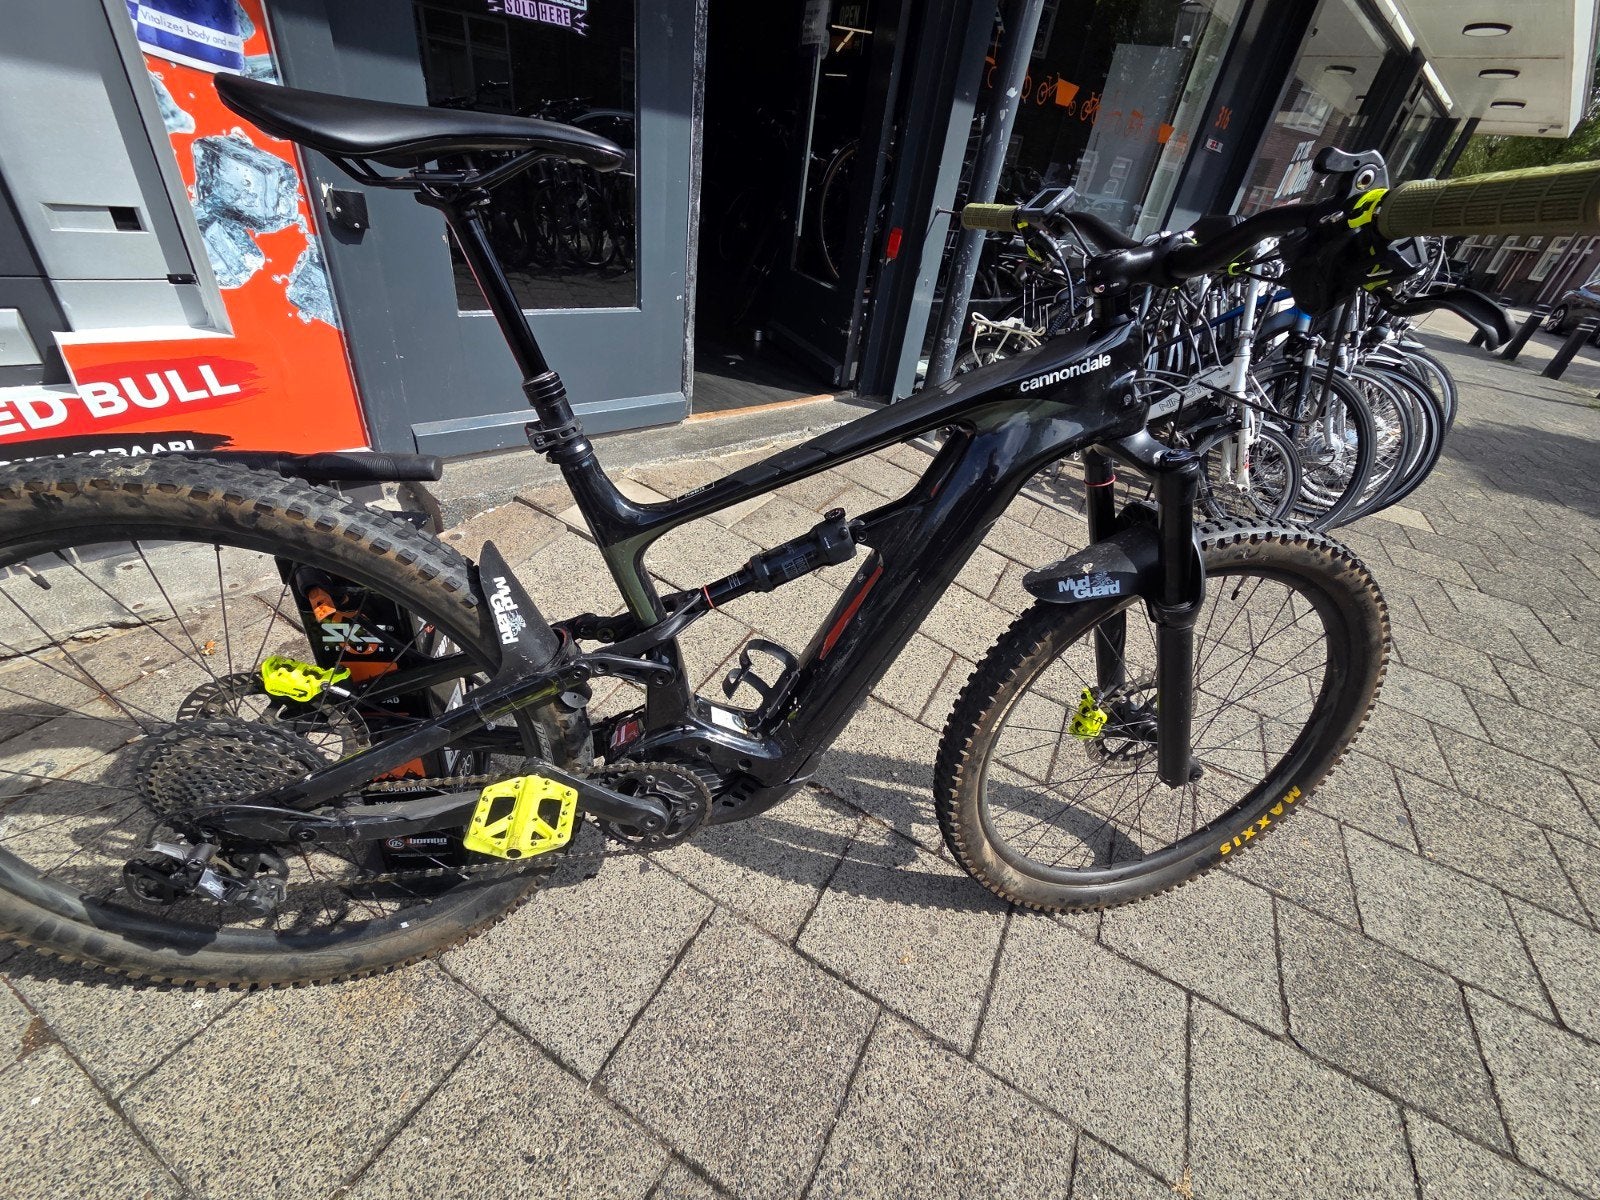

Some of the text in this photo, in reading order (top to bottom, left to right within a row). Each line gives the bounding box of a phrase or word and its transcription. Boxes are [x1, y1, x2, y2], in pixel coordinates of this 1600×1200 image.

[140, 9, 184, 33] Vitalizes
[186, 25, 211, 43] body
[213, 36, 227, 46] and
[505, 0, 536, 18] SOLD
[540, 5, 570, 25] HERE
[839, 5, 861, 26] OPEN
[1214, 105, 1232, 130] 316
[1020, 353, 1112, 392] cannondale
[78, 364, 242, 418] BULL
[493, 576, 519, 611] Mud
[1058, 575, 1090, 593] Mud
[1074, 579, 1120, 599] Guard
[490, 593, 520, 645] Guard
[324, 645, 395, 653] GERMANY
[1219, 785, 1302, 855] MAXXIS
